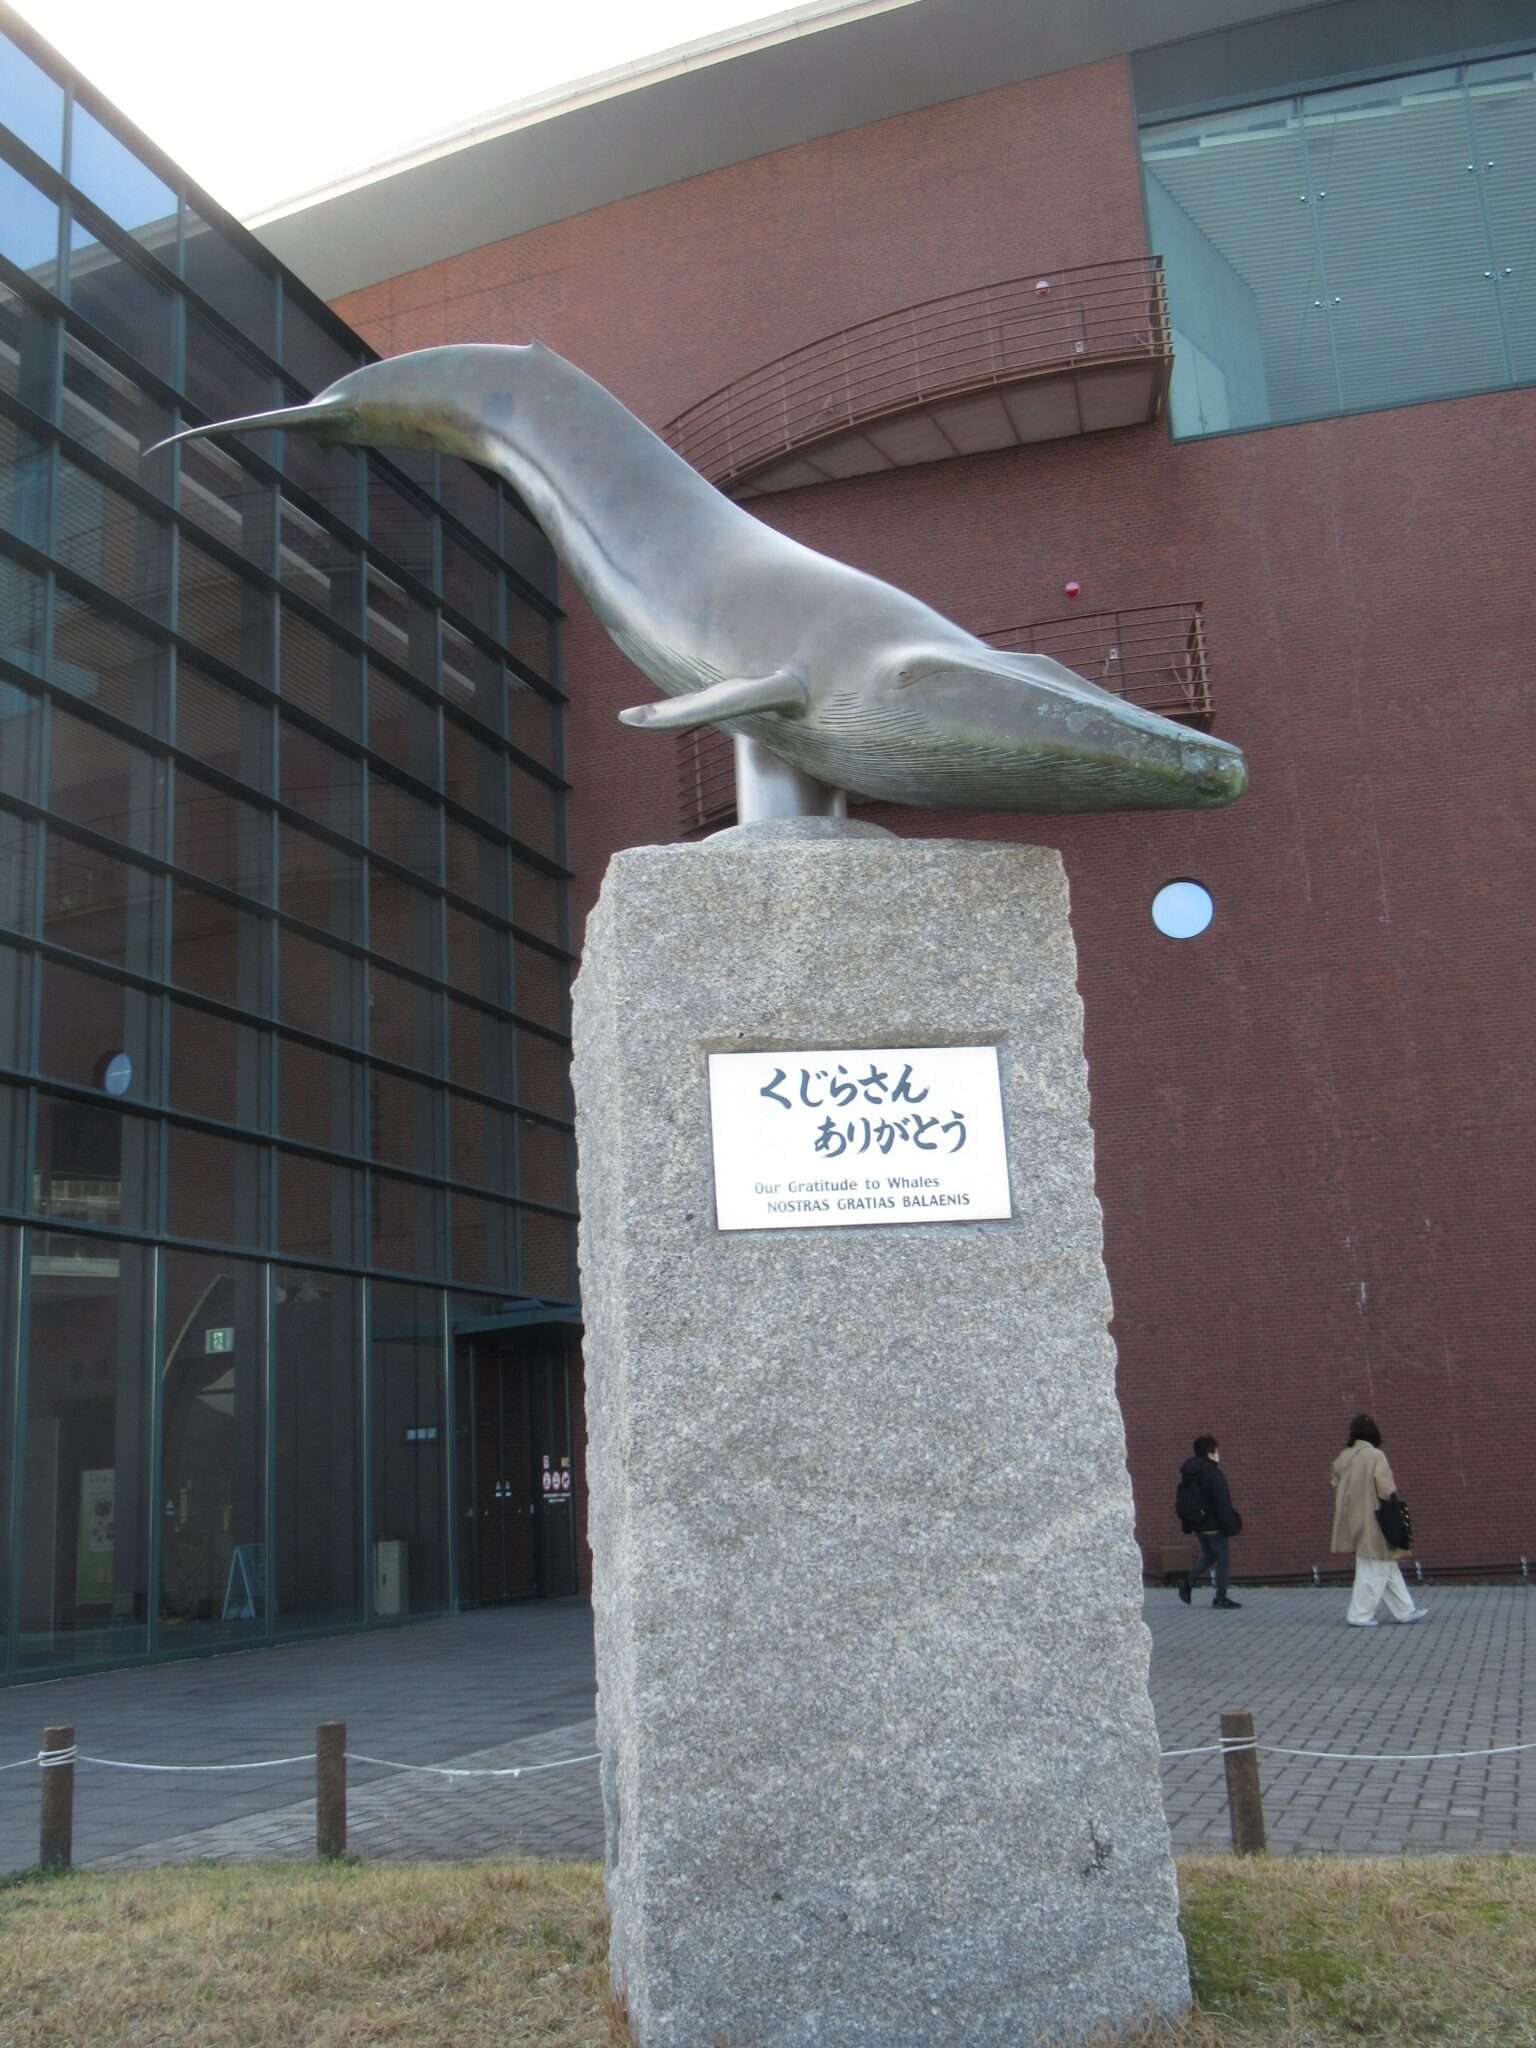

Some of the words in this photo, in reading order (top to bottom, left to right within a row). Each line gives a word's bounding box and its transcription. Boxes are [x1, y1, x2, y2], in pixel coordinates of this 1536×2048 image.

[760, 1063, 930, 1109] くじらさん
[814, 1110, 967, 1158] ありがとう
[755, 1182, 781, 1194] Our
[788, 1180, 857, 1193] Gratitude
[865, 1178, 880, 1190] to
[888, 1176, 940, 1188] Whales
[767, 1199, 830, 1213] NOSTRAS
[837, 1196, 895, 1210] GRATIAS
[903, 1193, 970, 1208] BALAENIS
